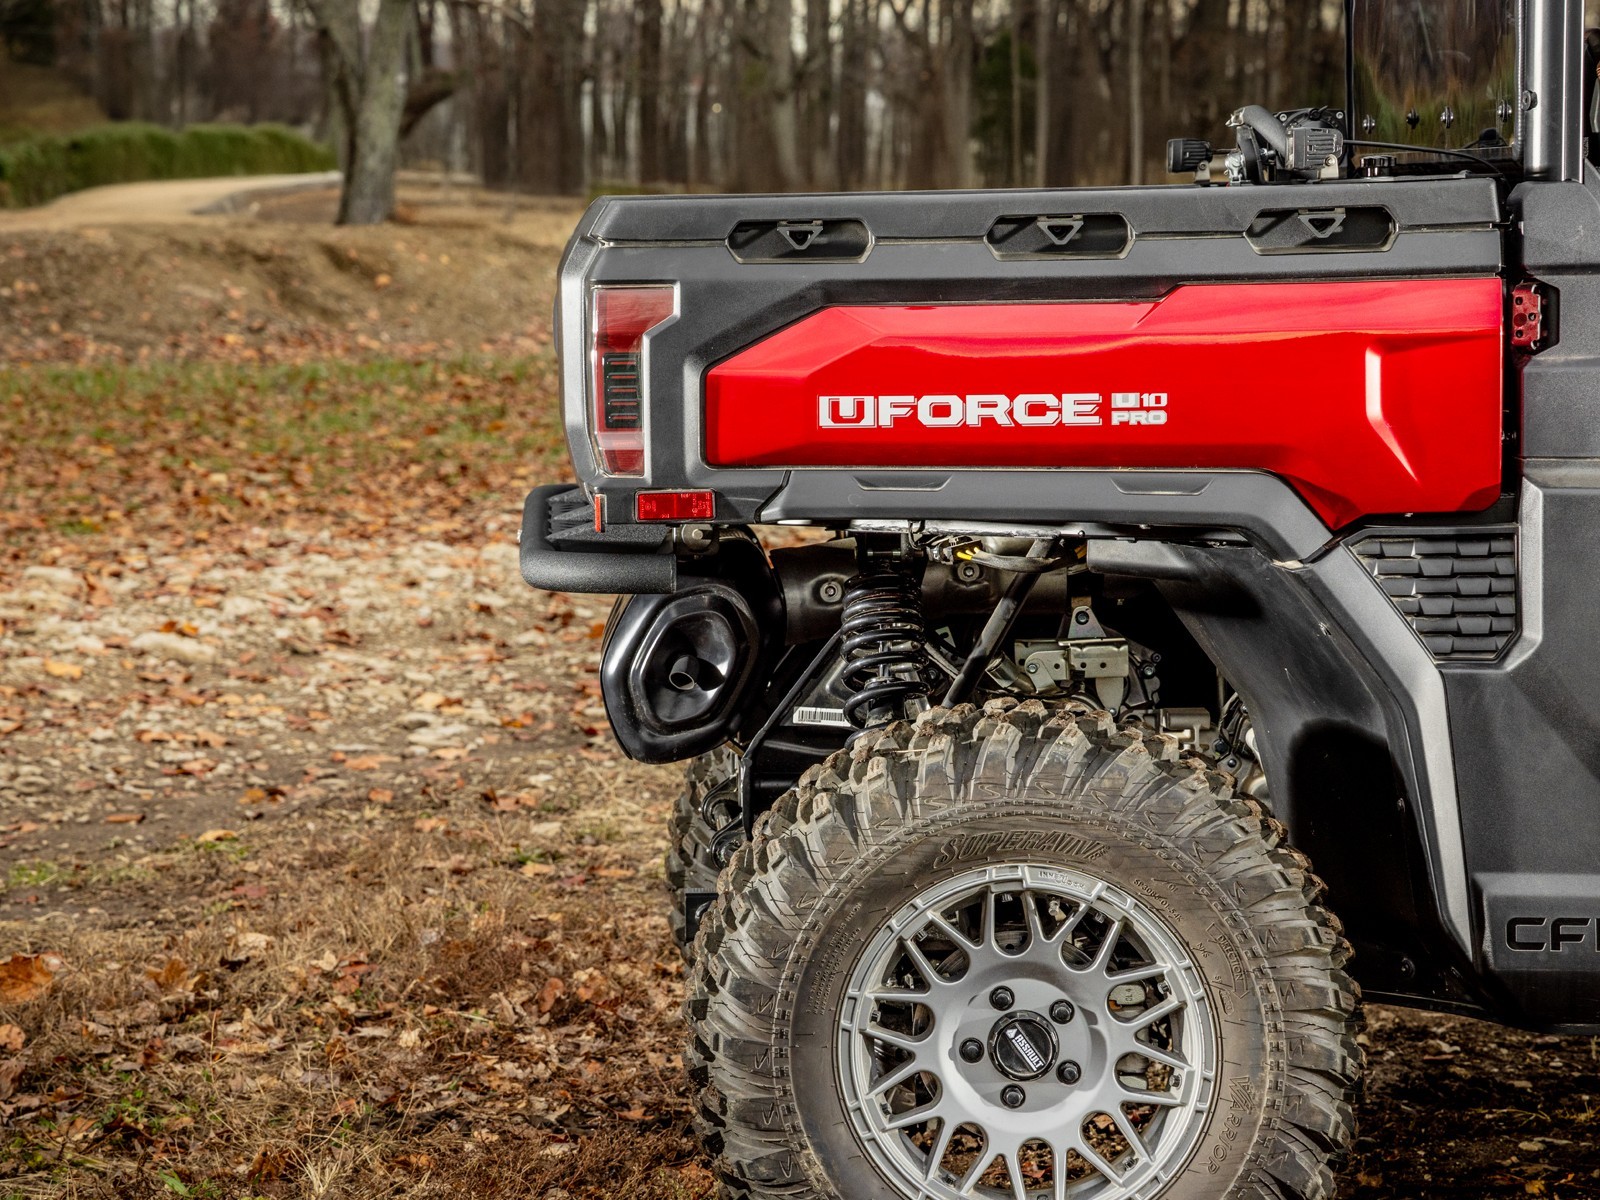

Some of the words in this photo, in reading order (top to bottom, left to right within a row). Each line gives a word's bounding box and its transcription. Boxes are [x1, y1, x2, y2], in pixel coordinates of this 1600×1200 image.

[1111, 392, 1168, 408] U10
[1111, 410, 1168, 425] PRO
[1505, 916, 1600, 952] CF
[1217, 935, 1244, 982] DIRECTION
[1014, 1033, 1044, 1068] ASSAULT
[1206, 1075, 1256, 1175] WARRIOR
